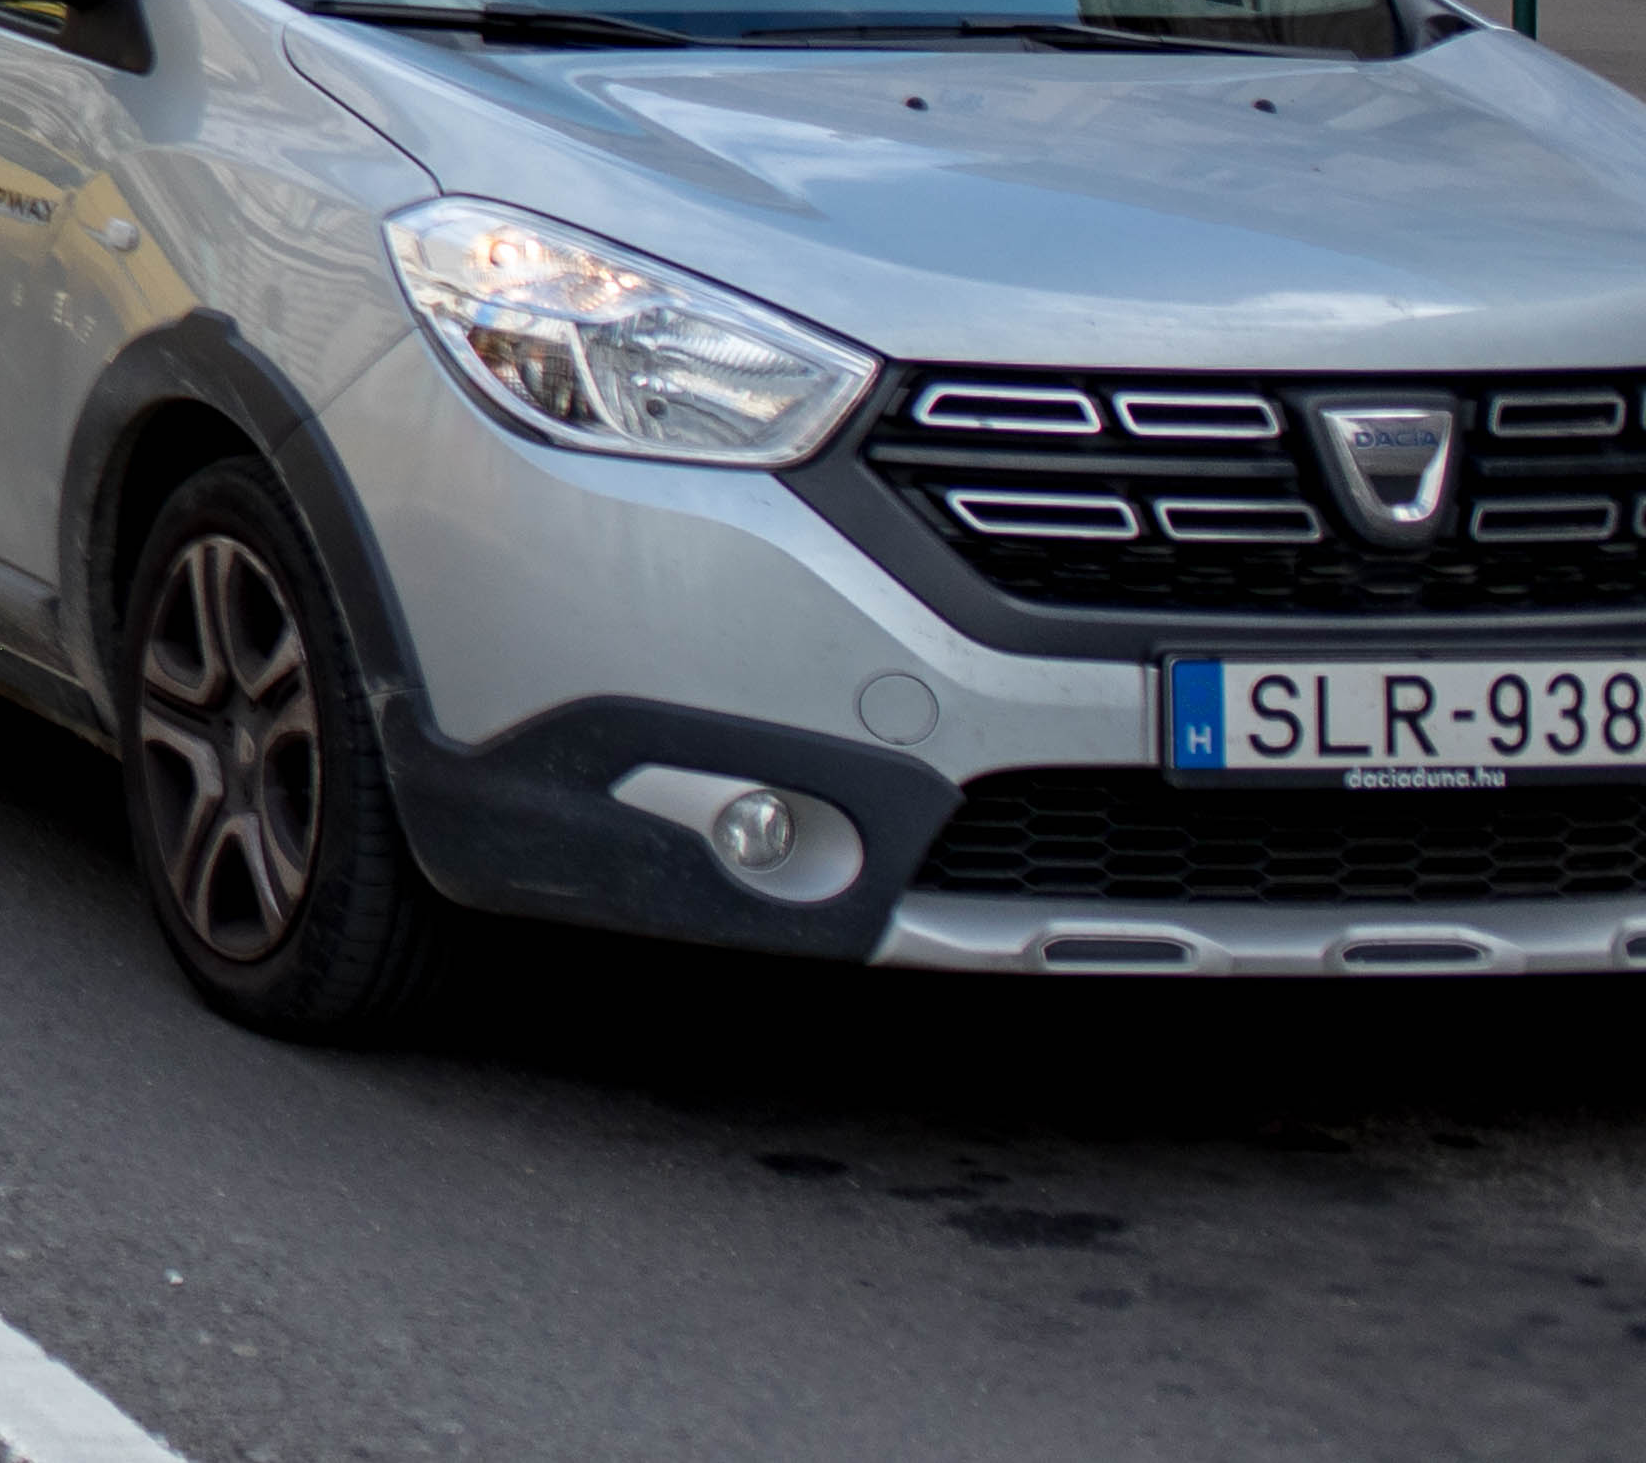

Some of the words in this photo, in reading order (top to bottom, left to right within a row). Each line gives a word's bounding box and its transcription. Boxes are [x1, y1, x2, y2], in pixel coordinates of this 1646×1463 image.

[1353, 430, 1440, 448] DACIA
[1185, 725, 1213, 755] H
[1248, 673, 1644, 759] SLR-938
[1344, 765, 1507, 789] daciaduna.hu
